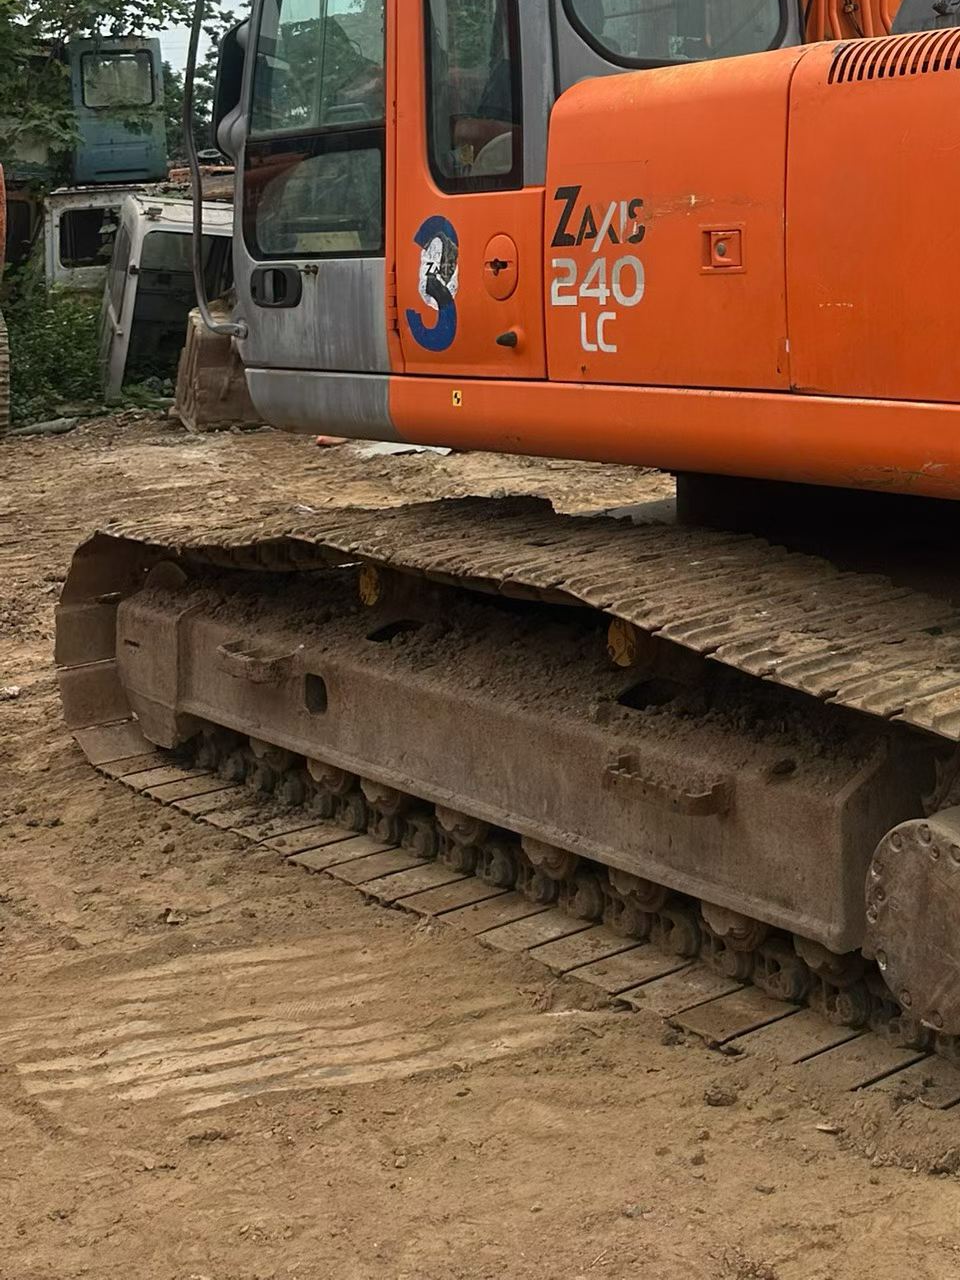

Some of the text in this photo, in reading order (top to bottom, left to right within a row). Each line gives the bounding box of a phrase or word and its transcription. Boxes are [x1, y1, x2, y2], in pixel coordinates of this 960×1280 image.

[551, 185, 646, 253] ZAXIS
[551, 255, 645, 307] 240
[580, 311, 618, 353] LC
